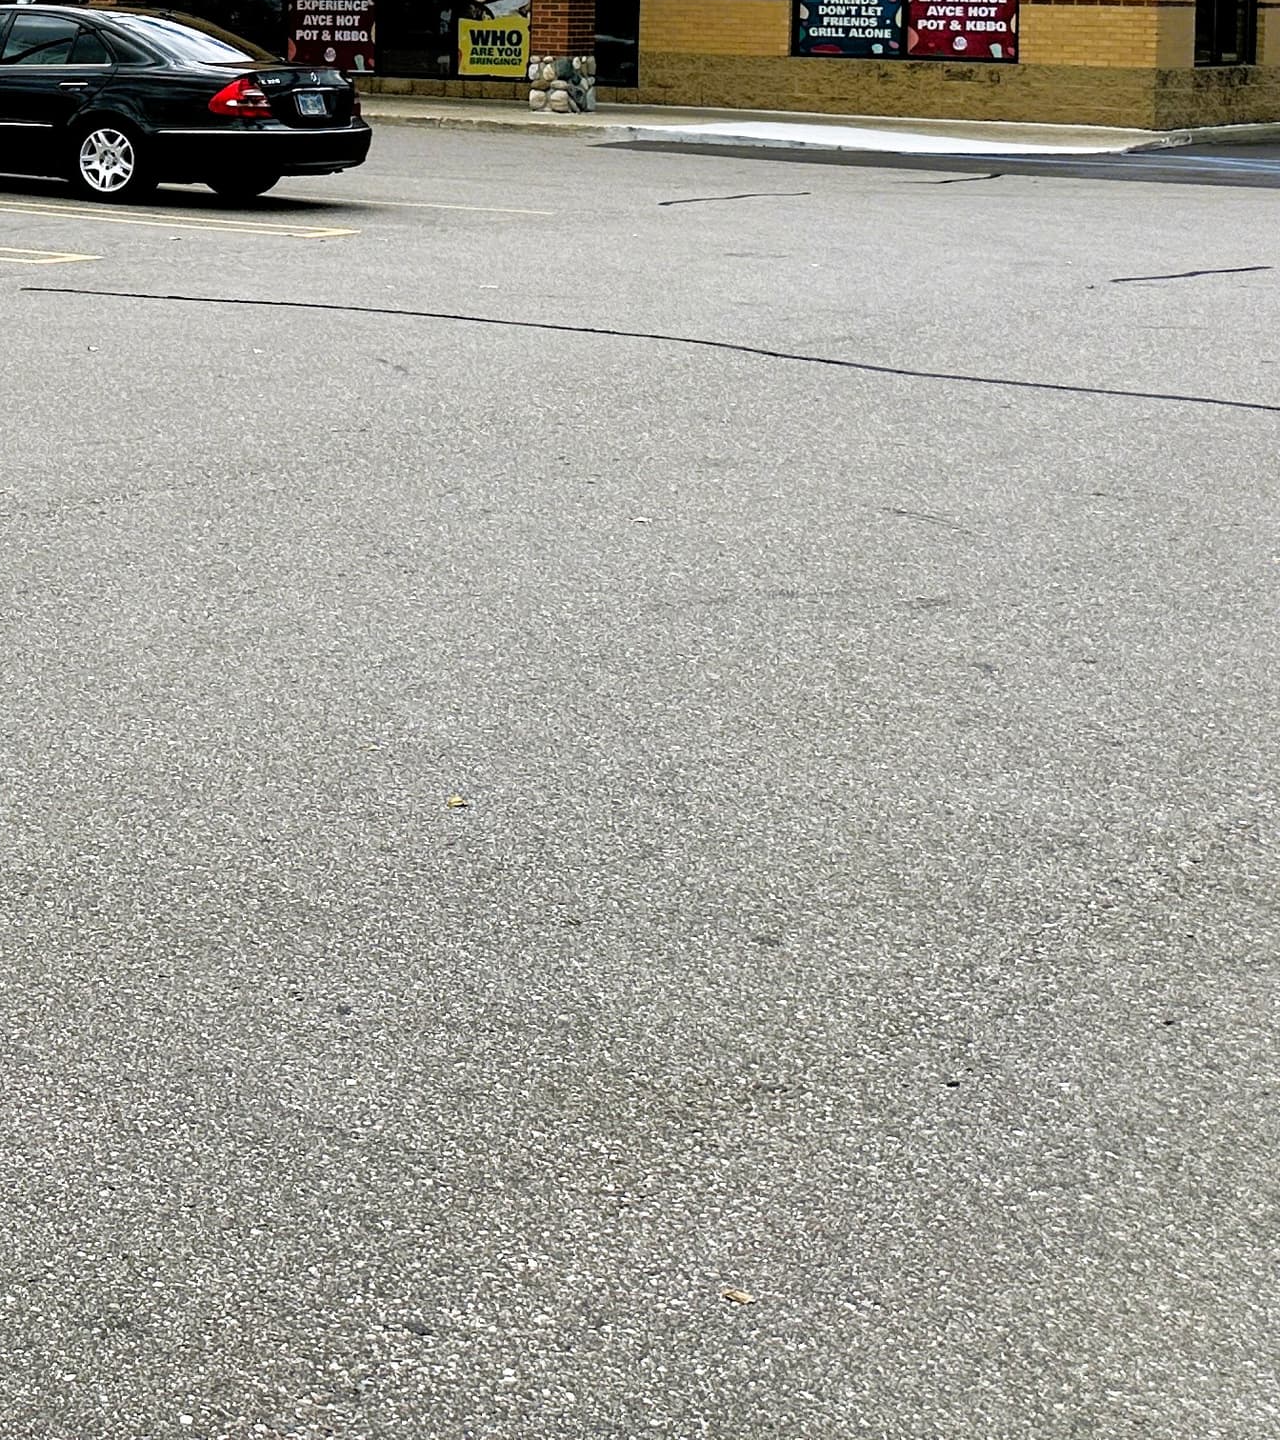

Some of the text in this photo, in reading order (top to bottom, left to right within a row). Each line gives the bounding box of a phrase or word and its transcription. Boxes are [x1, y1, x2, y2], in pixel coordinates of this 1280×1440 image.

[296, 0, 369, 11] EXPERIENCE
[818, 6, 883, 16] DON'T LET
[926, 6, 998, 17] AYCE HOT
[303, 15, 361, 26] AYCE HOT
[823, 17, 878, 27] FRIENDS
[917, 20, 1007, 32] POT & KBBQ
[295, 29, 369, 42] POT & KBBQ
[469, 29, 523, 47] WHO
[809, 27, 892, 38] GRILL ALONE
[470, 47, 522, 57] ARE YOU
[470, 57, 522, 66] BRINGING?
